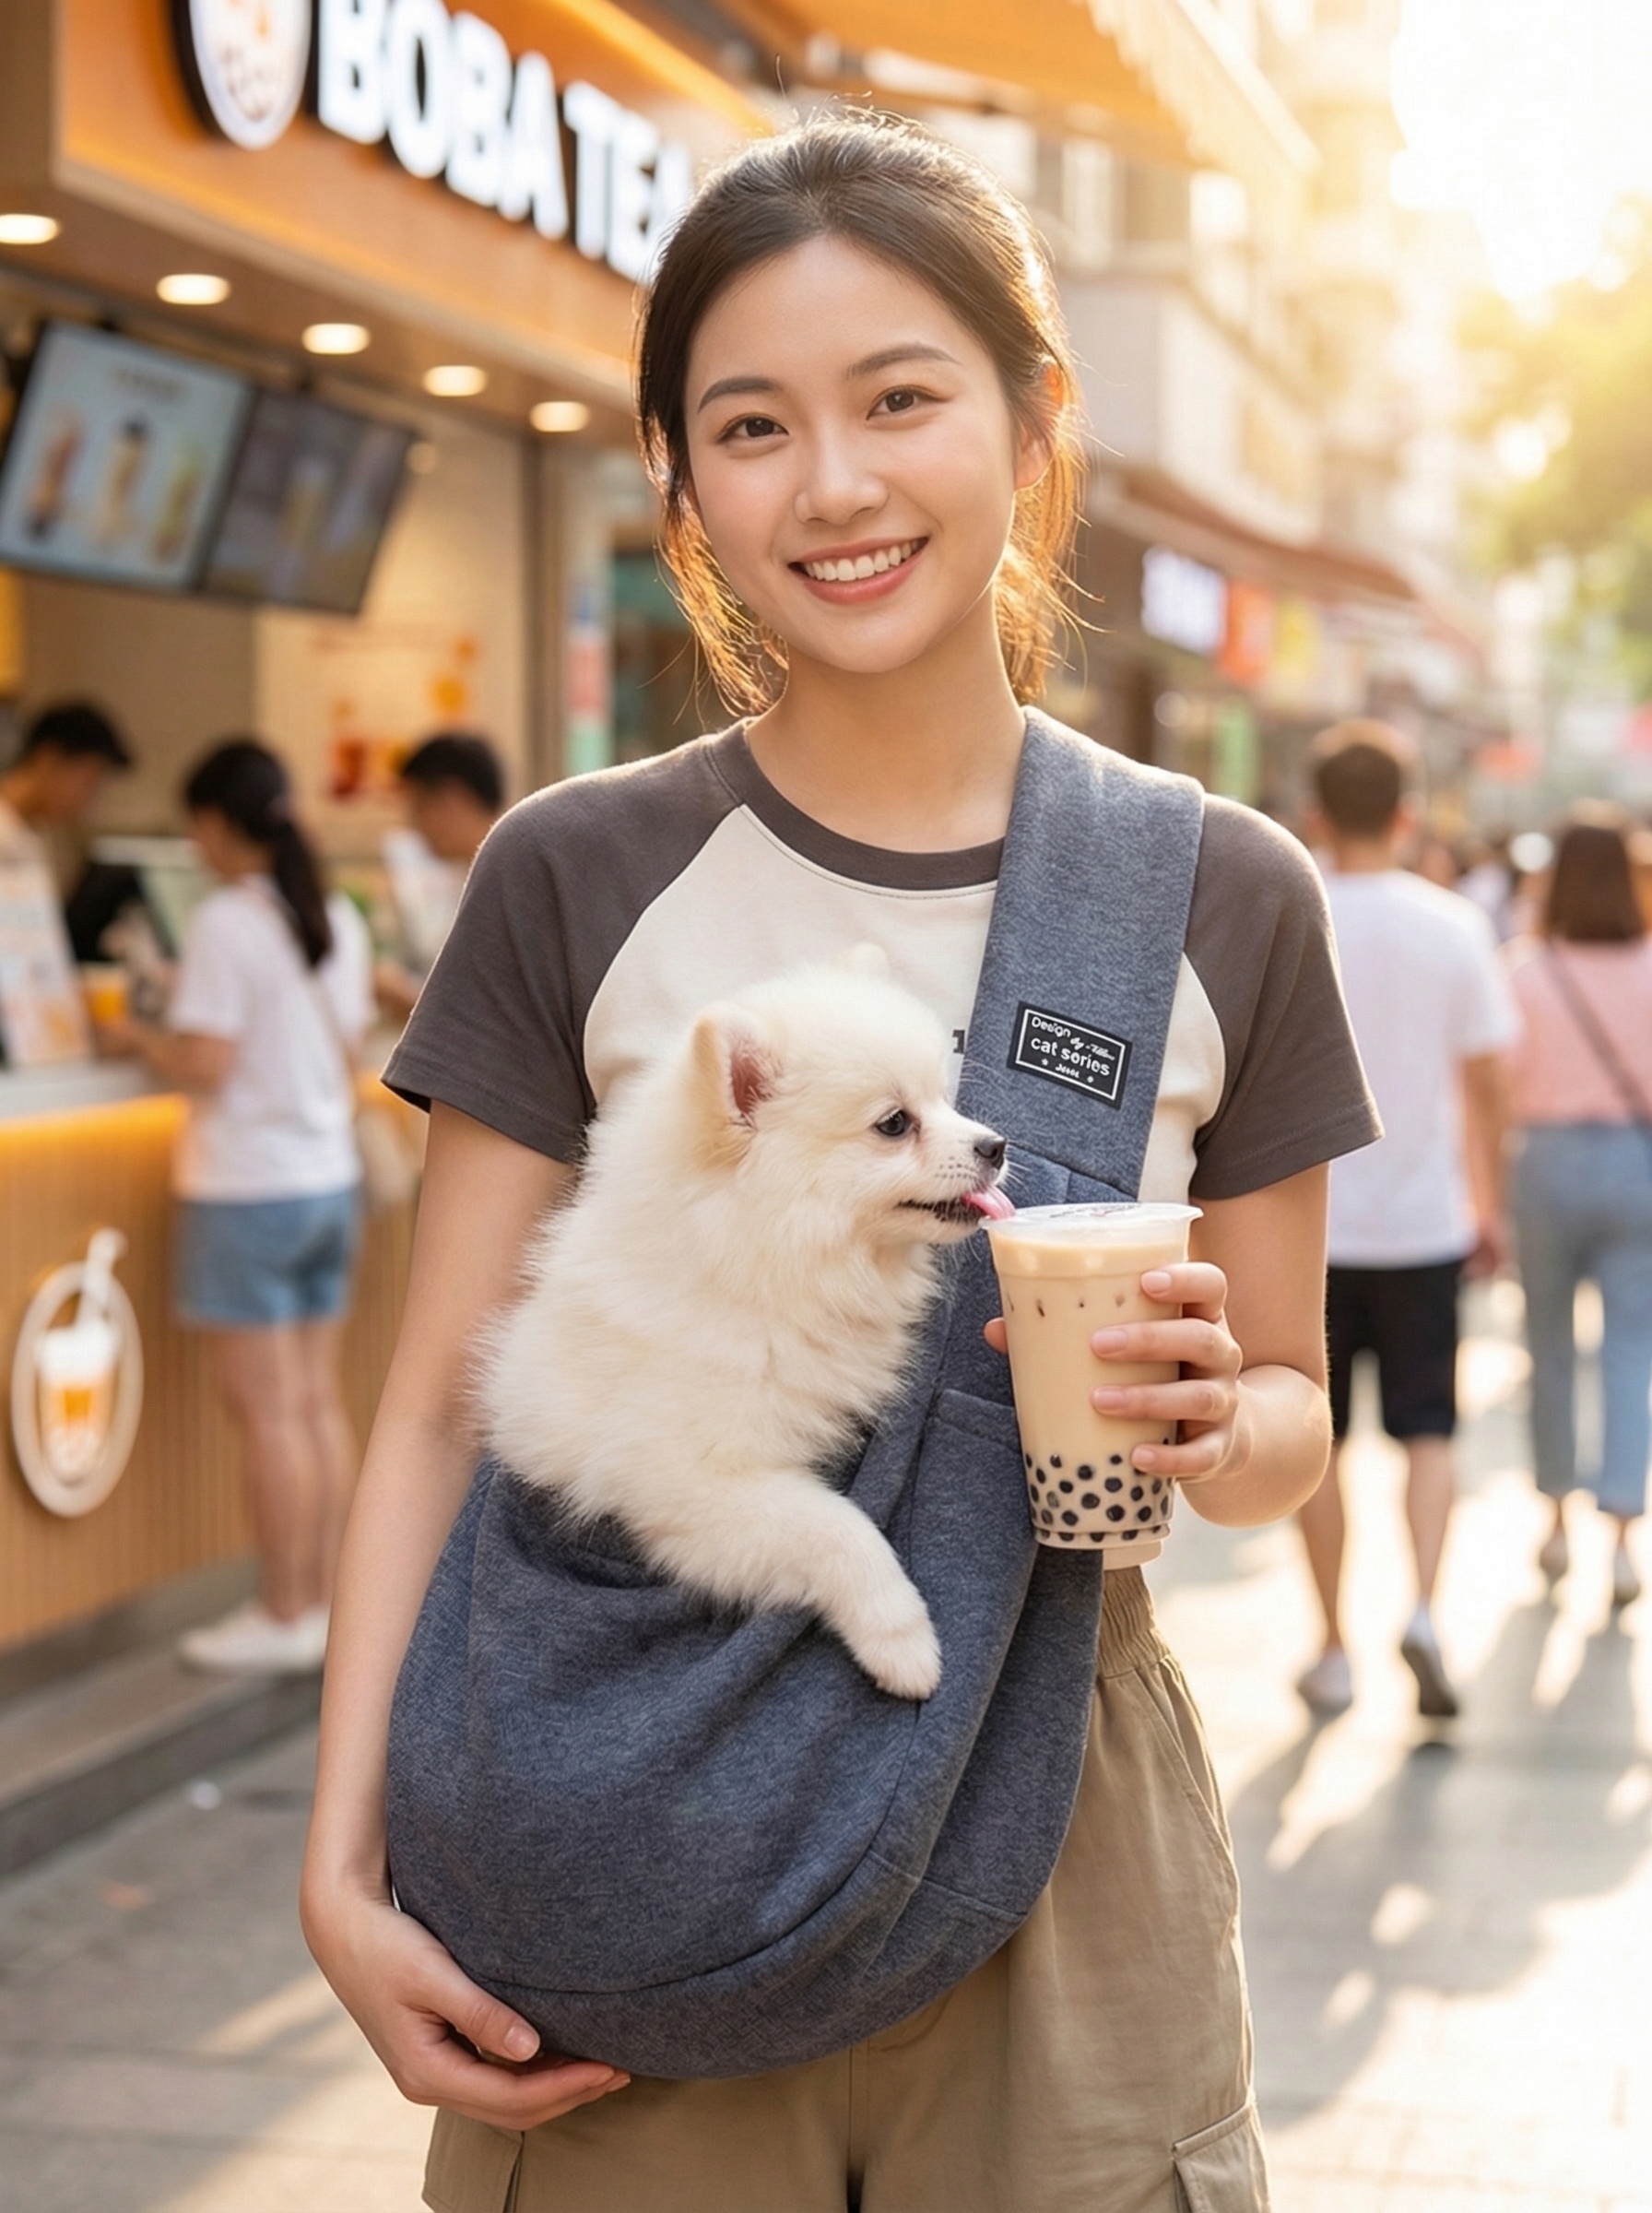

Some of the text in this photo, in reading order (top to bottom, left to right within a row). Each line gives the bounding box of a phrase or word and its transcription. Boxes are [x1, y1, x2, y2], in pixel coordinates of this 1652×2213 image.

[318, 0, 568, 241] BOBA
[1032, 1016, 1071, 1037] Design
[1031, 1037, 1057, 1057] cat
